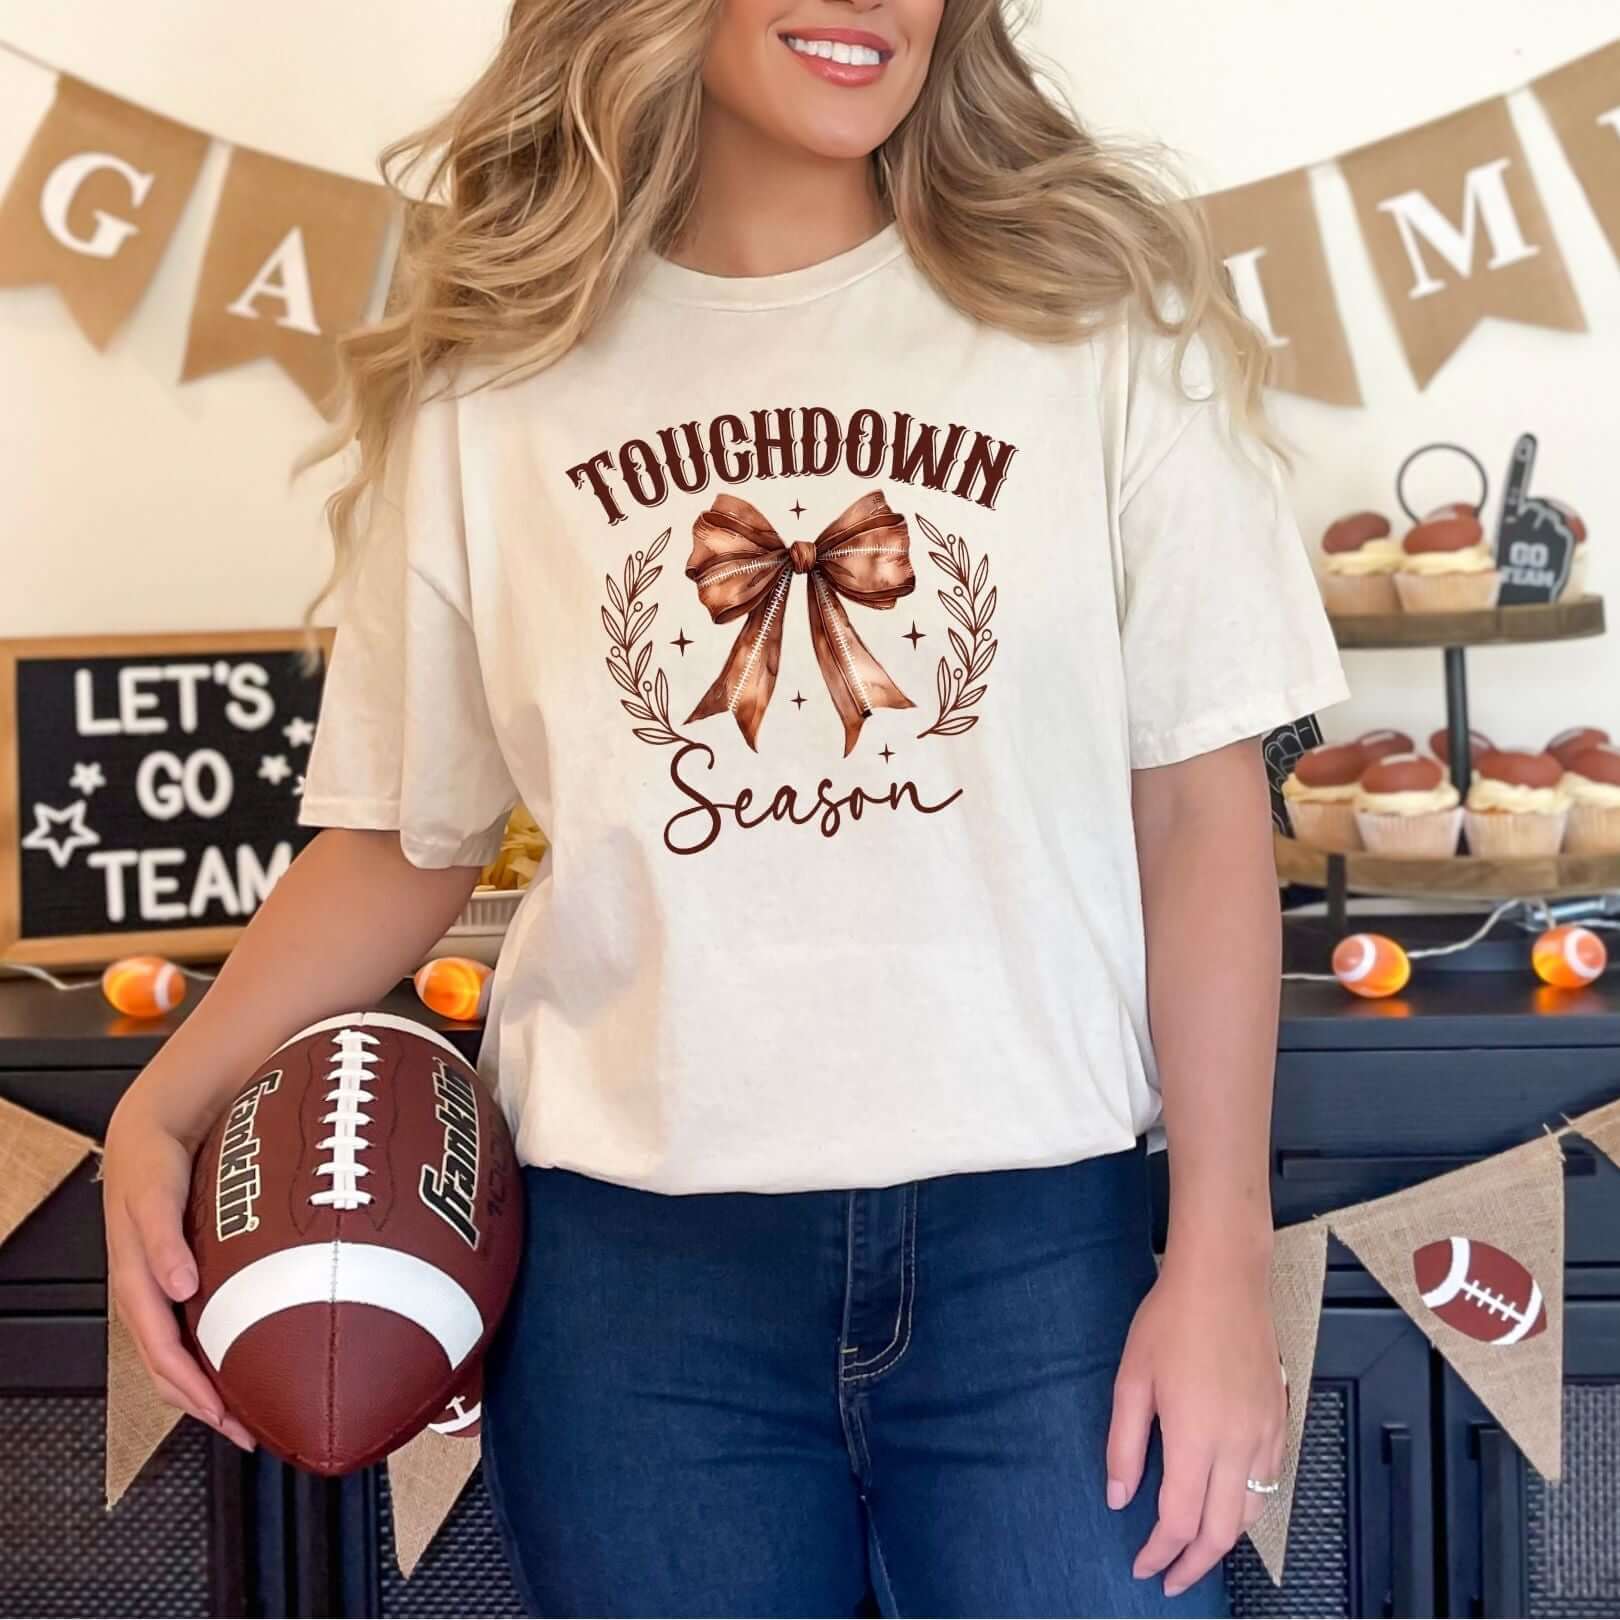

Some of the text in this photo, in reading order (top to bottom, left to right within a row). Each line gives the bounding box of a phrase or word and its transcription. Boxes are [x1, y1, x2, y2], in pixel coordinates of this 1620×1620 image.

[565, 405, 1020, 527] TOUCHDOWN
[1509, 541, 1549, 568] GO
[75, 661, 275, 736] LET'S
[136, 748, 234, 820] GO
[663, 742, 964, 856] Season
[87, 841, 293, 922] TEAM
[216, 1069, 283, 1242] Franklin
